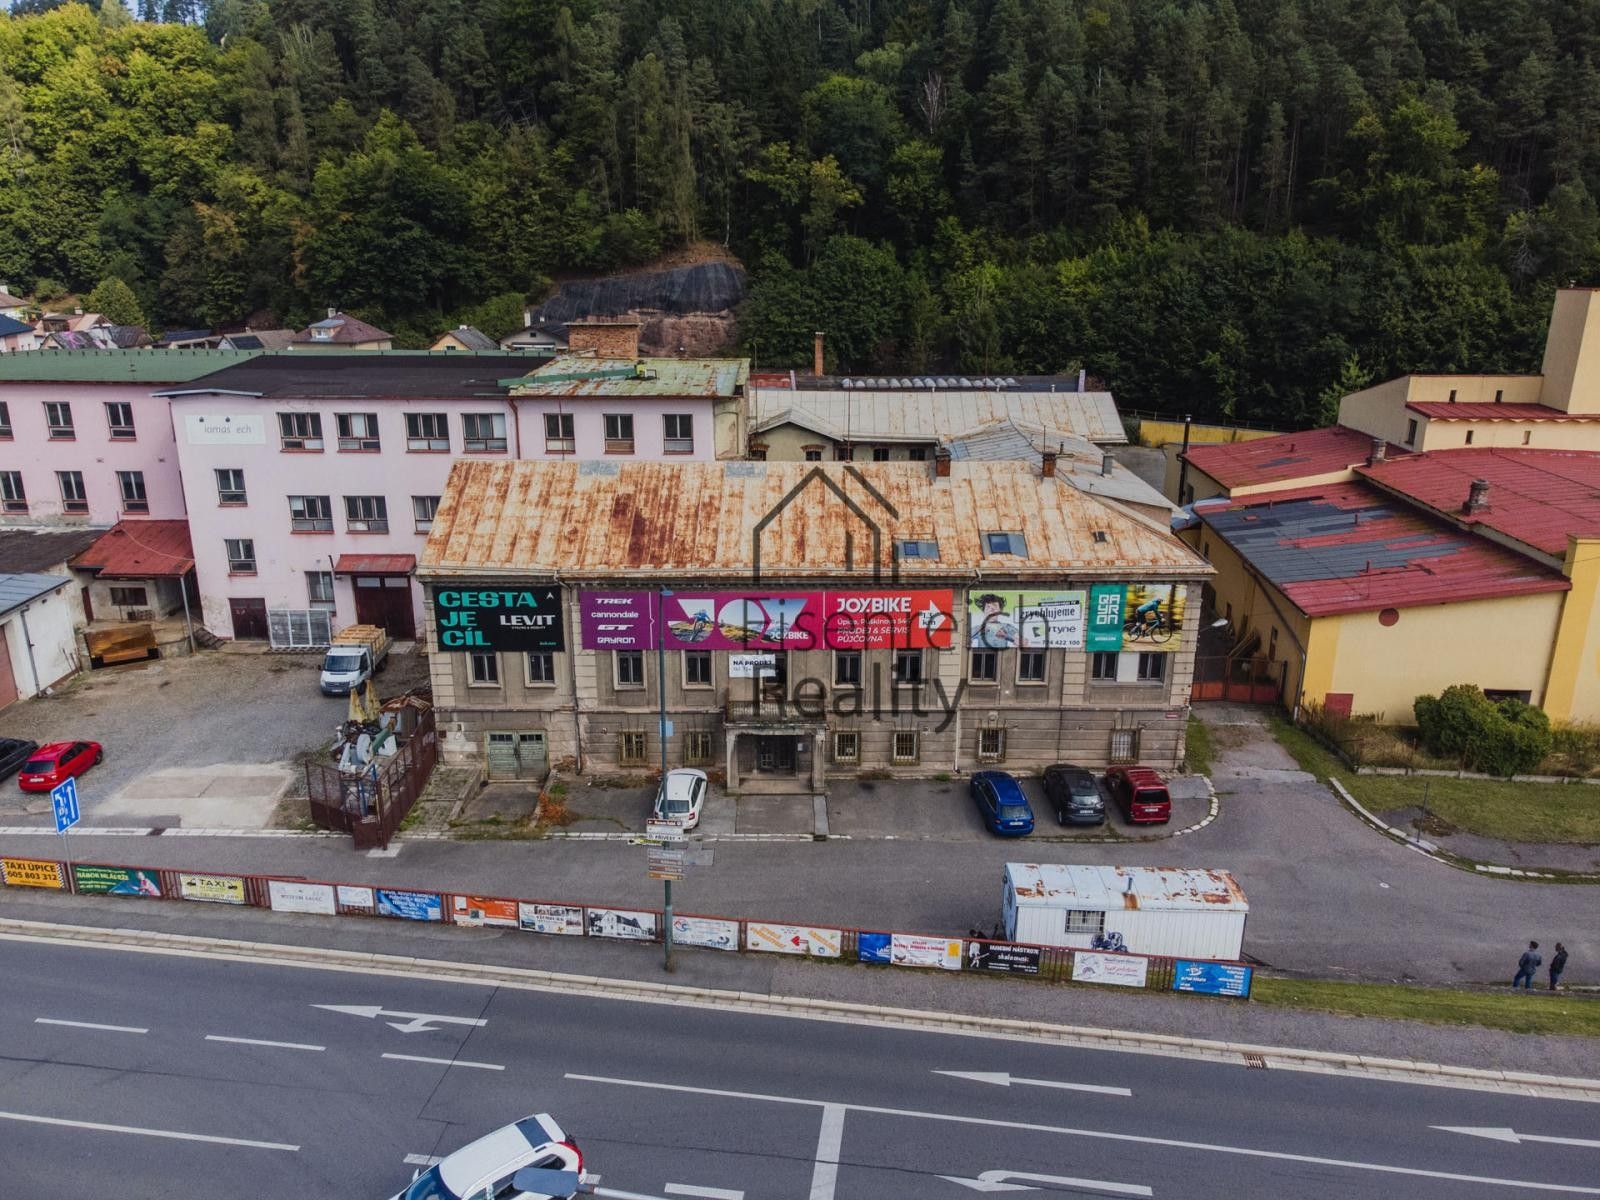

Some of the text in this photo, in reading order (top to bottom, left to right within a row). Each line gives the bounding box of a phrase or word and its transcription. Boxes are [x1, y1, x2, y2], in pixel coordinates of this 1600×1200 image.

[438, 591, 538, 608] CESTA
[837, 597, 912, 613] JOY.BIKE
[440, 611, 477, 627] JE
[499, 615, 556, 626] LEVIT
[591, 610, 639, 618] cannondale
[442, 627, 491, 646] CÍL
[4, 861, 57, 873] TAXI ÚPICE
[199, 879, 225, 888] TAXI
